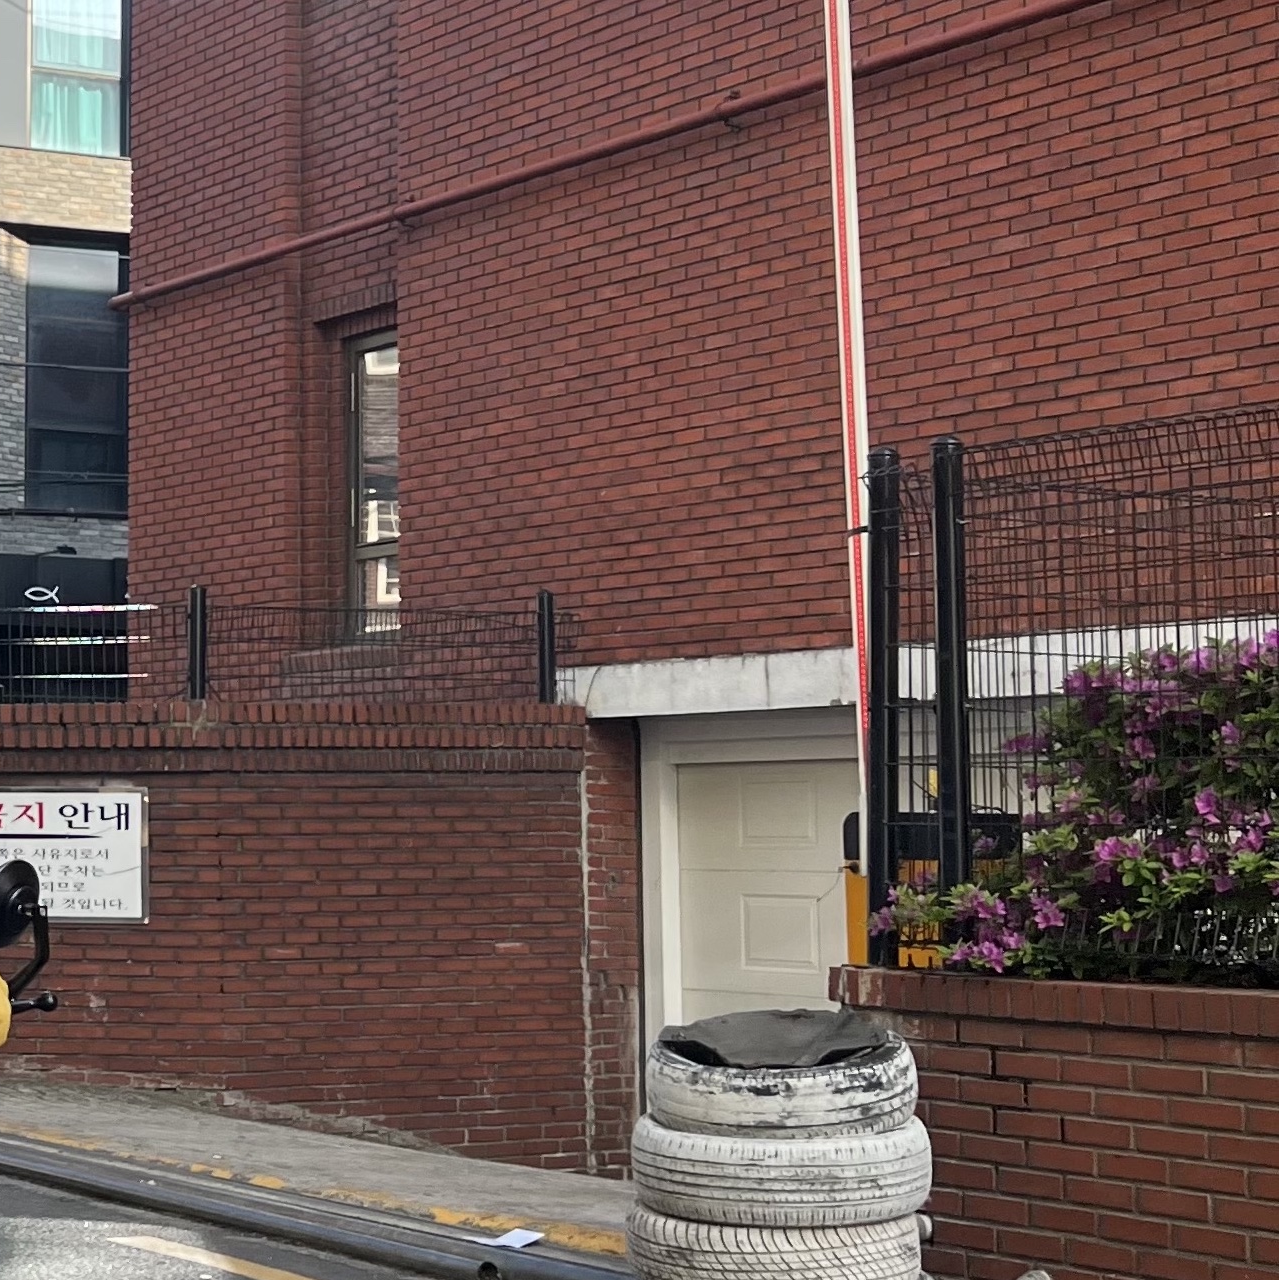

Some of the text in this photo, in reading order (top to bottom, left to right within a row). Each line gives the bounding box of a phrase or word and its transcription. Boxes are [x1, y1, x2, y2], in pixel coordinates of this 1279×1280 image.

[58, 801, 130, 831] 안내
[32, 848, 109, 860] 사유지로서
[58, 865, 104, 877] 주차는
